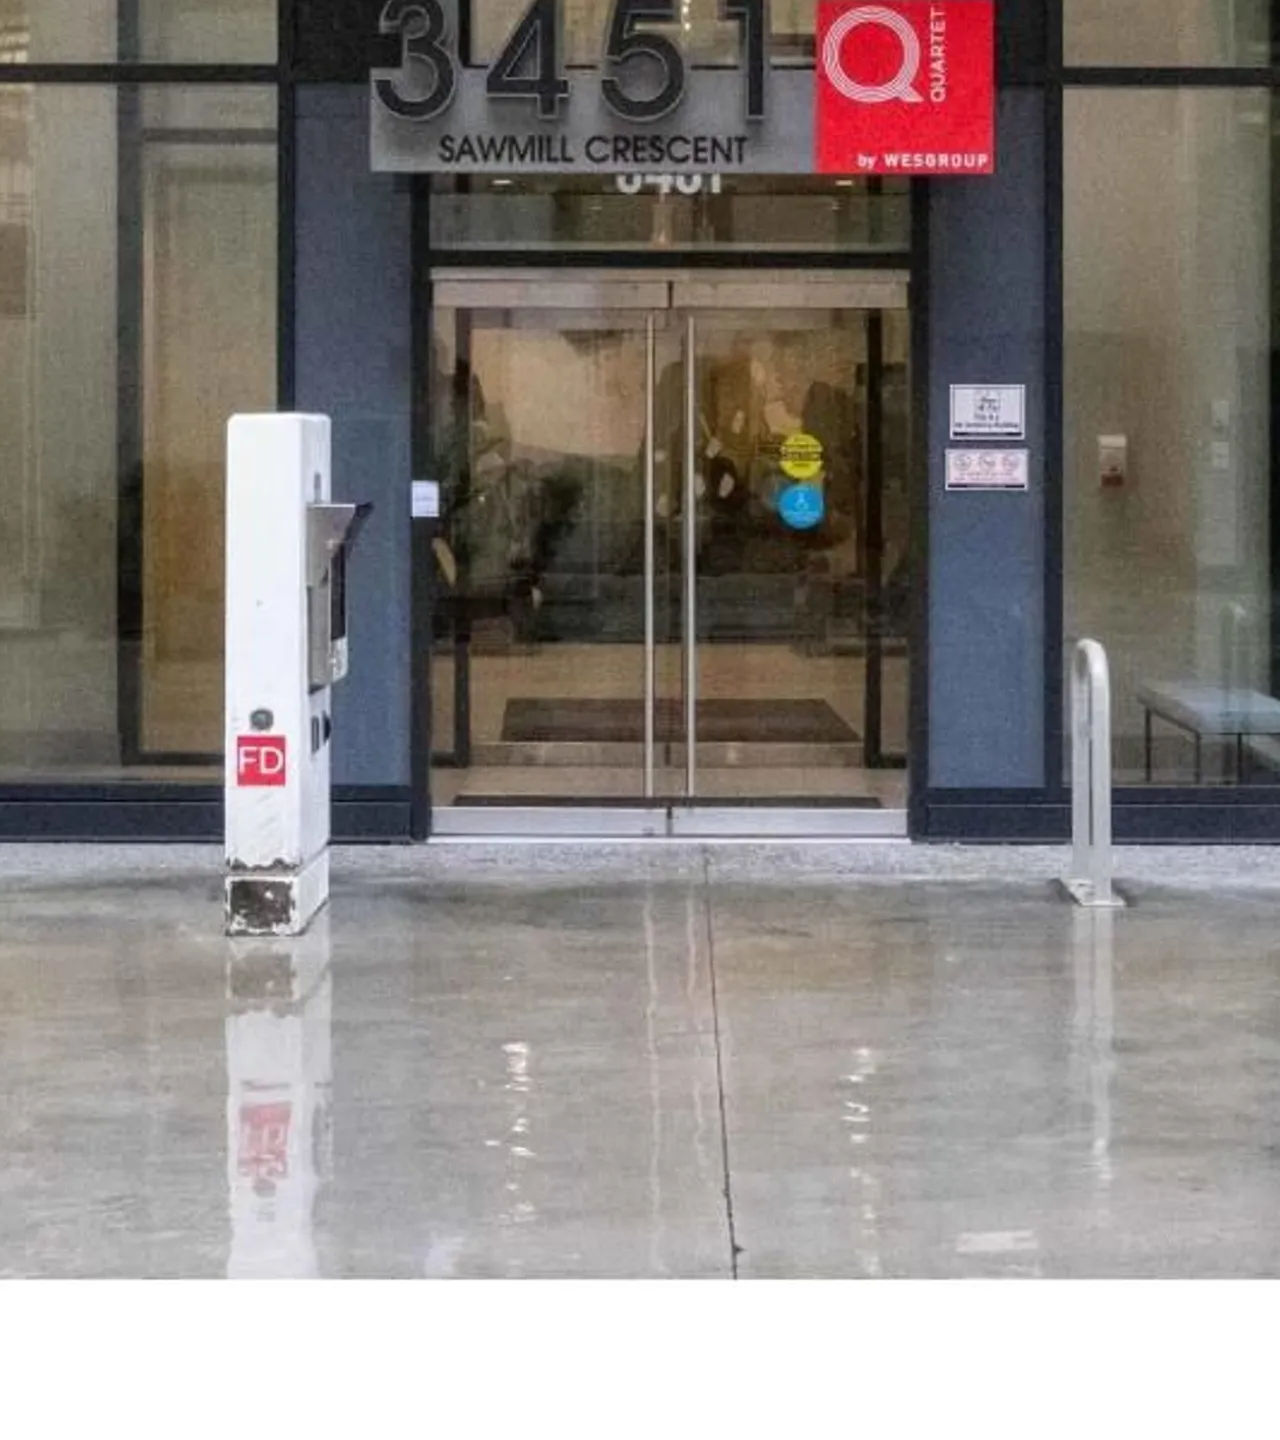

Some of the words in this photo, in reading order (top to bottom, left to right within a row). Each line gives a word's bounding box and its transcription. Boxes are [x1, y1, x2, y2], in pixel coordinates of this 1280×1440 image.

[822, 5, 924, 103] Q
[930, 6, 947, 102] QUARTET
[438, 133, 574, 164] SAWMILL
[584, 134, 749, 165] CRESCENT
[856, 153, 878, 169] by
[883, 153, 989, 168] WESGROUP
[238, 746, 284, 774] FD
